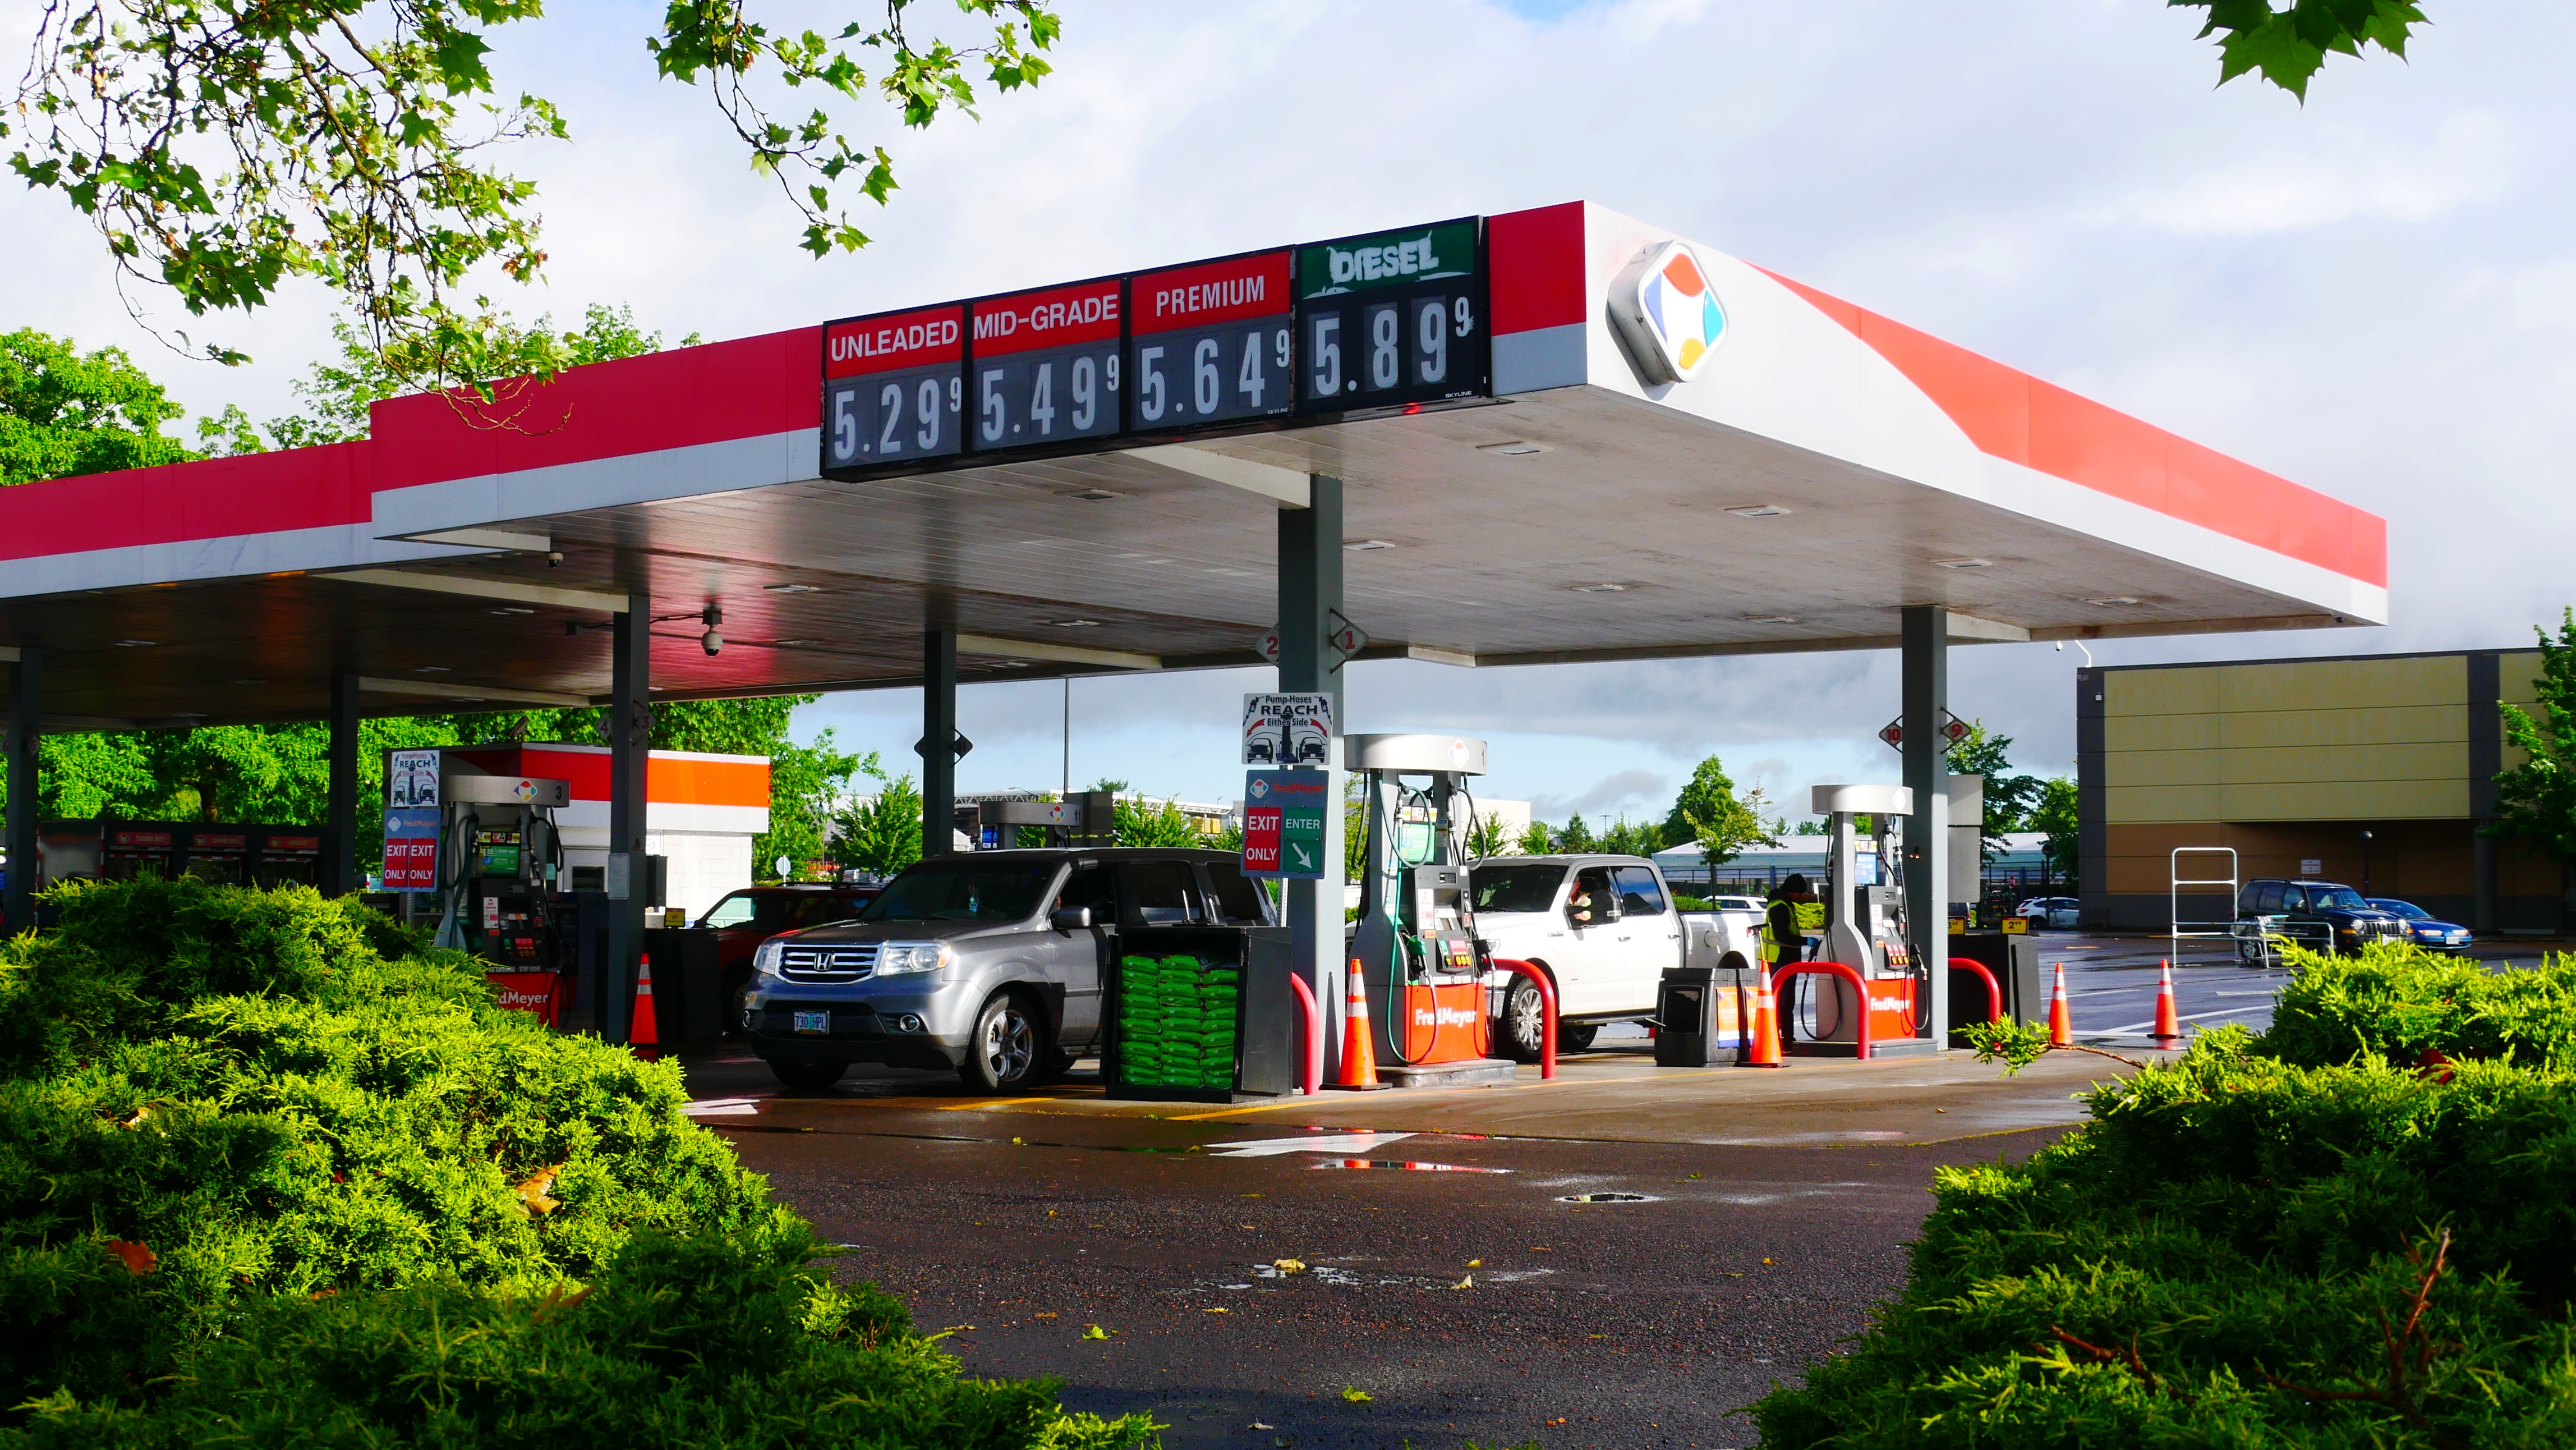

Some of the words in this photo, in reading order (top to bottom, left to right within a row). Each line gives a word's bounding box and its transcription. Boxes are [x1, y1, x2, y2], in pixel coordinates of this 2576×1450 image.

[1329, 231, 1439, 284] DIESEL
[1156, 275, 1265, 317] PREMIUM
[973, 294, 1119, 340] MID-GRADE
[831, 320, 958, 361] UNLEADED
[1266, 636, 1278, 655] 2
[1345, 630, 1355, 649] 1
[1266, 695, 1288, 704] Pump
[1290, 695, 1312, 704] Hoses
[1261, 704, 1318, 716] REACH
[600, 719, 608, 733] 4
[642, 715, 650, 729] 3
[1267, 717, 1290, 727] Either
[1292, 717, 1309, 727] Side
[1887, 728, 1901, 741] 10
[1951, 724, 1962, 737] 9
[555, 786, 561, 799] 3
[1248, 815, 1279, 831] EXIT
[1285, 818, 1321, 829] ENTER
[387, 845, 408, 856] EXIT
[411, 845, 434, 857] EXIT
[1246, 847, 1277, 862] ONLY
[384, 869, 407, 879] ONLY
[410, 869, 433, 880] ONLY
[499, 991, 549, 1007] dMeyer
[795, 1016, 808, 1027] 730
[812, 1016, 826, 1029] HPL
